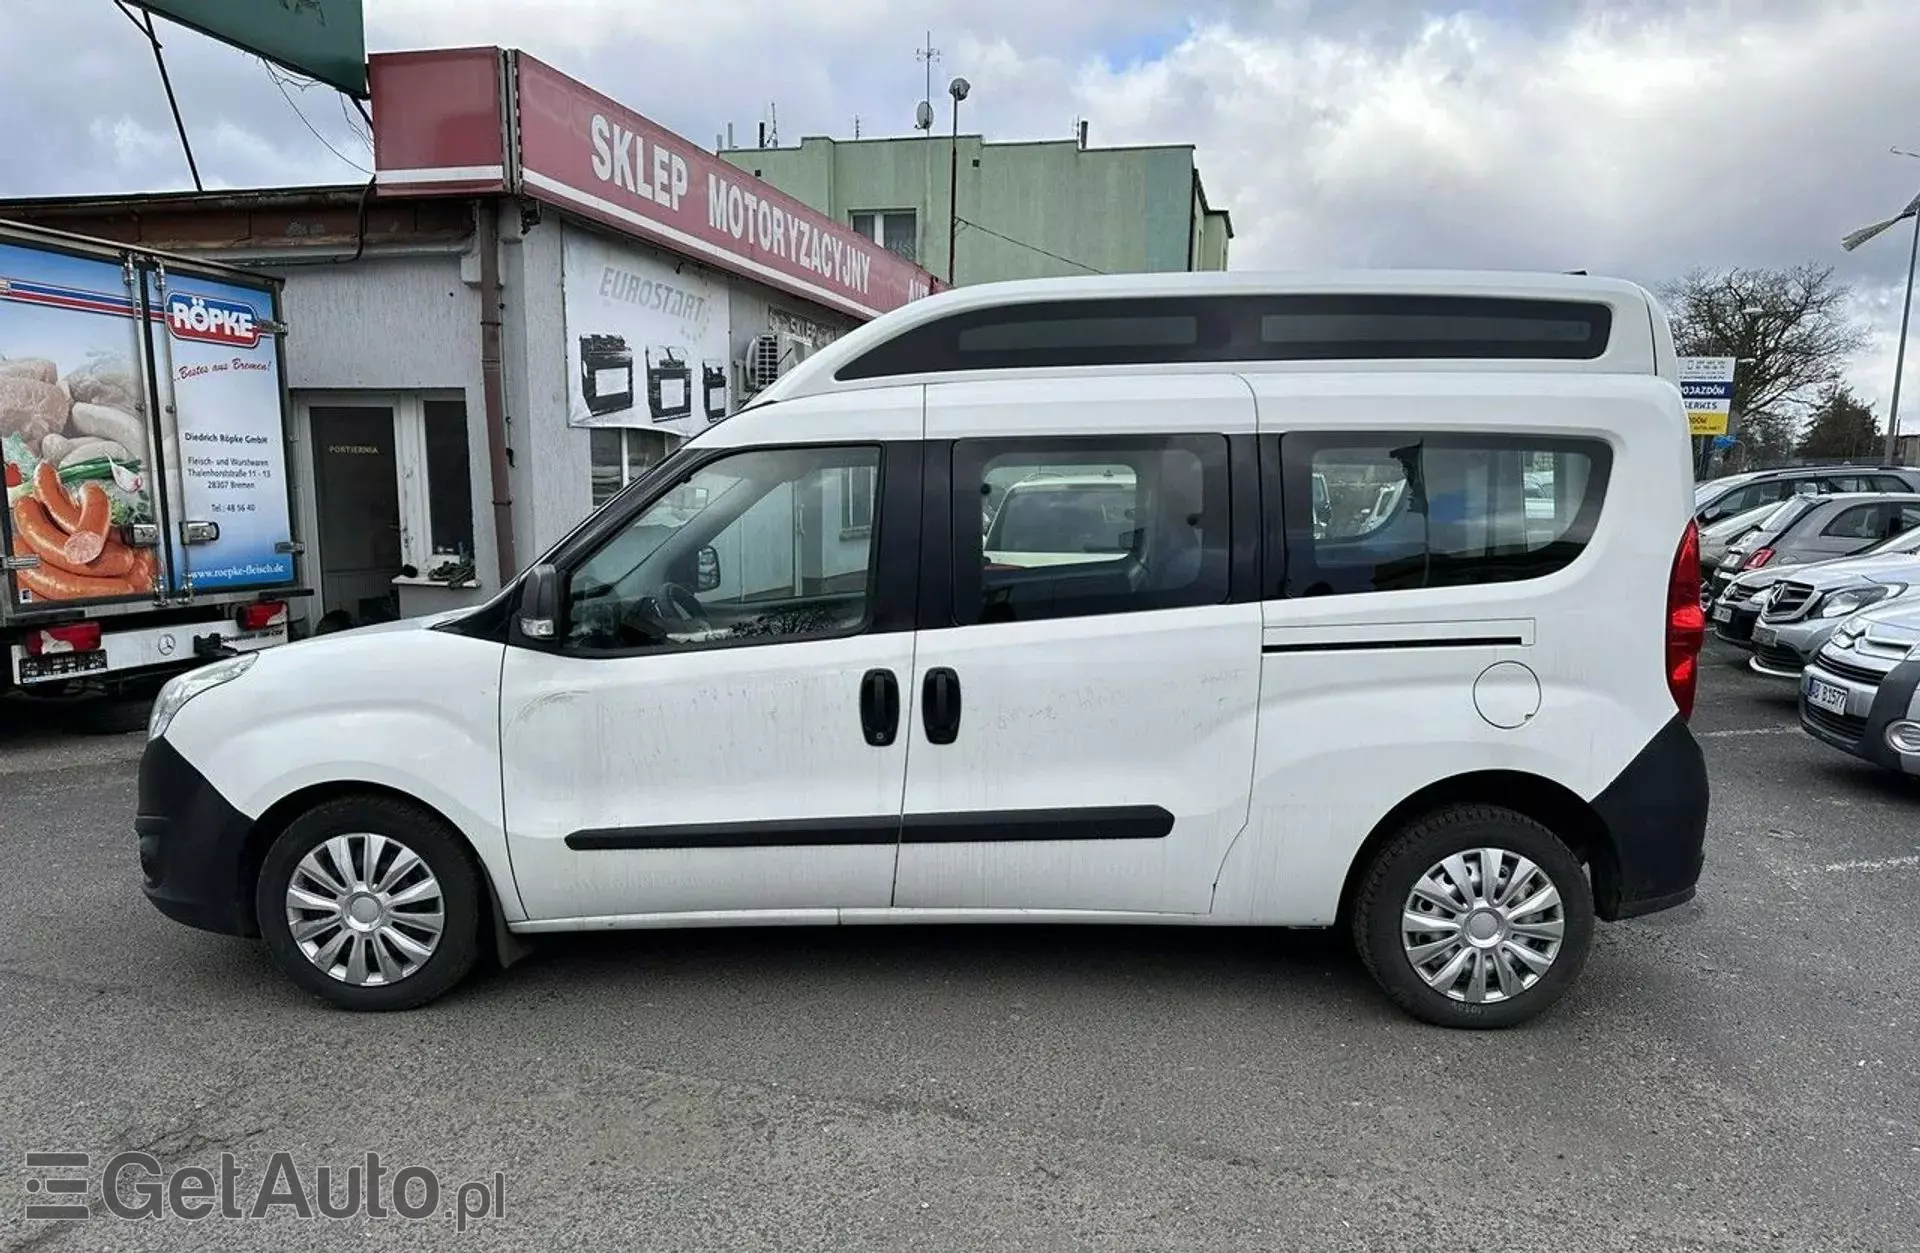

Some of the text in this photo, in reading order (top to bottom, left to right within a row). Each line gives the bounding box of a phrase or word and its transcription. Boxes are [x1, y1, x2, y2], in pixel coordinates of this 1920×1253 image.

[591, 114, 688, 211] SKLEP
[708, 172, 871, 295] MOTORYZACYJNY
[599, 267, 705, 322] EUROSTART
[172, 297, 254, 338] RÖPKE
[232, 357, 272, 371] Bremen!
[1681, 384, 1725, 396] OJAZDÓW
[185, 432, 268, 444] Diedrich Röpke GmbH
[216, 458, 229, 466] und
[230, 481, 255, 489] Bremen
